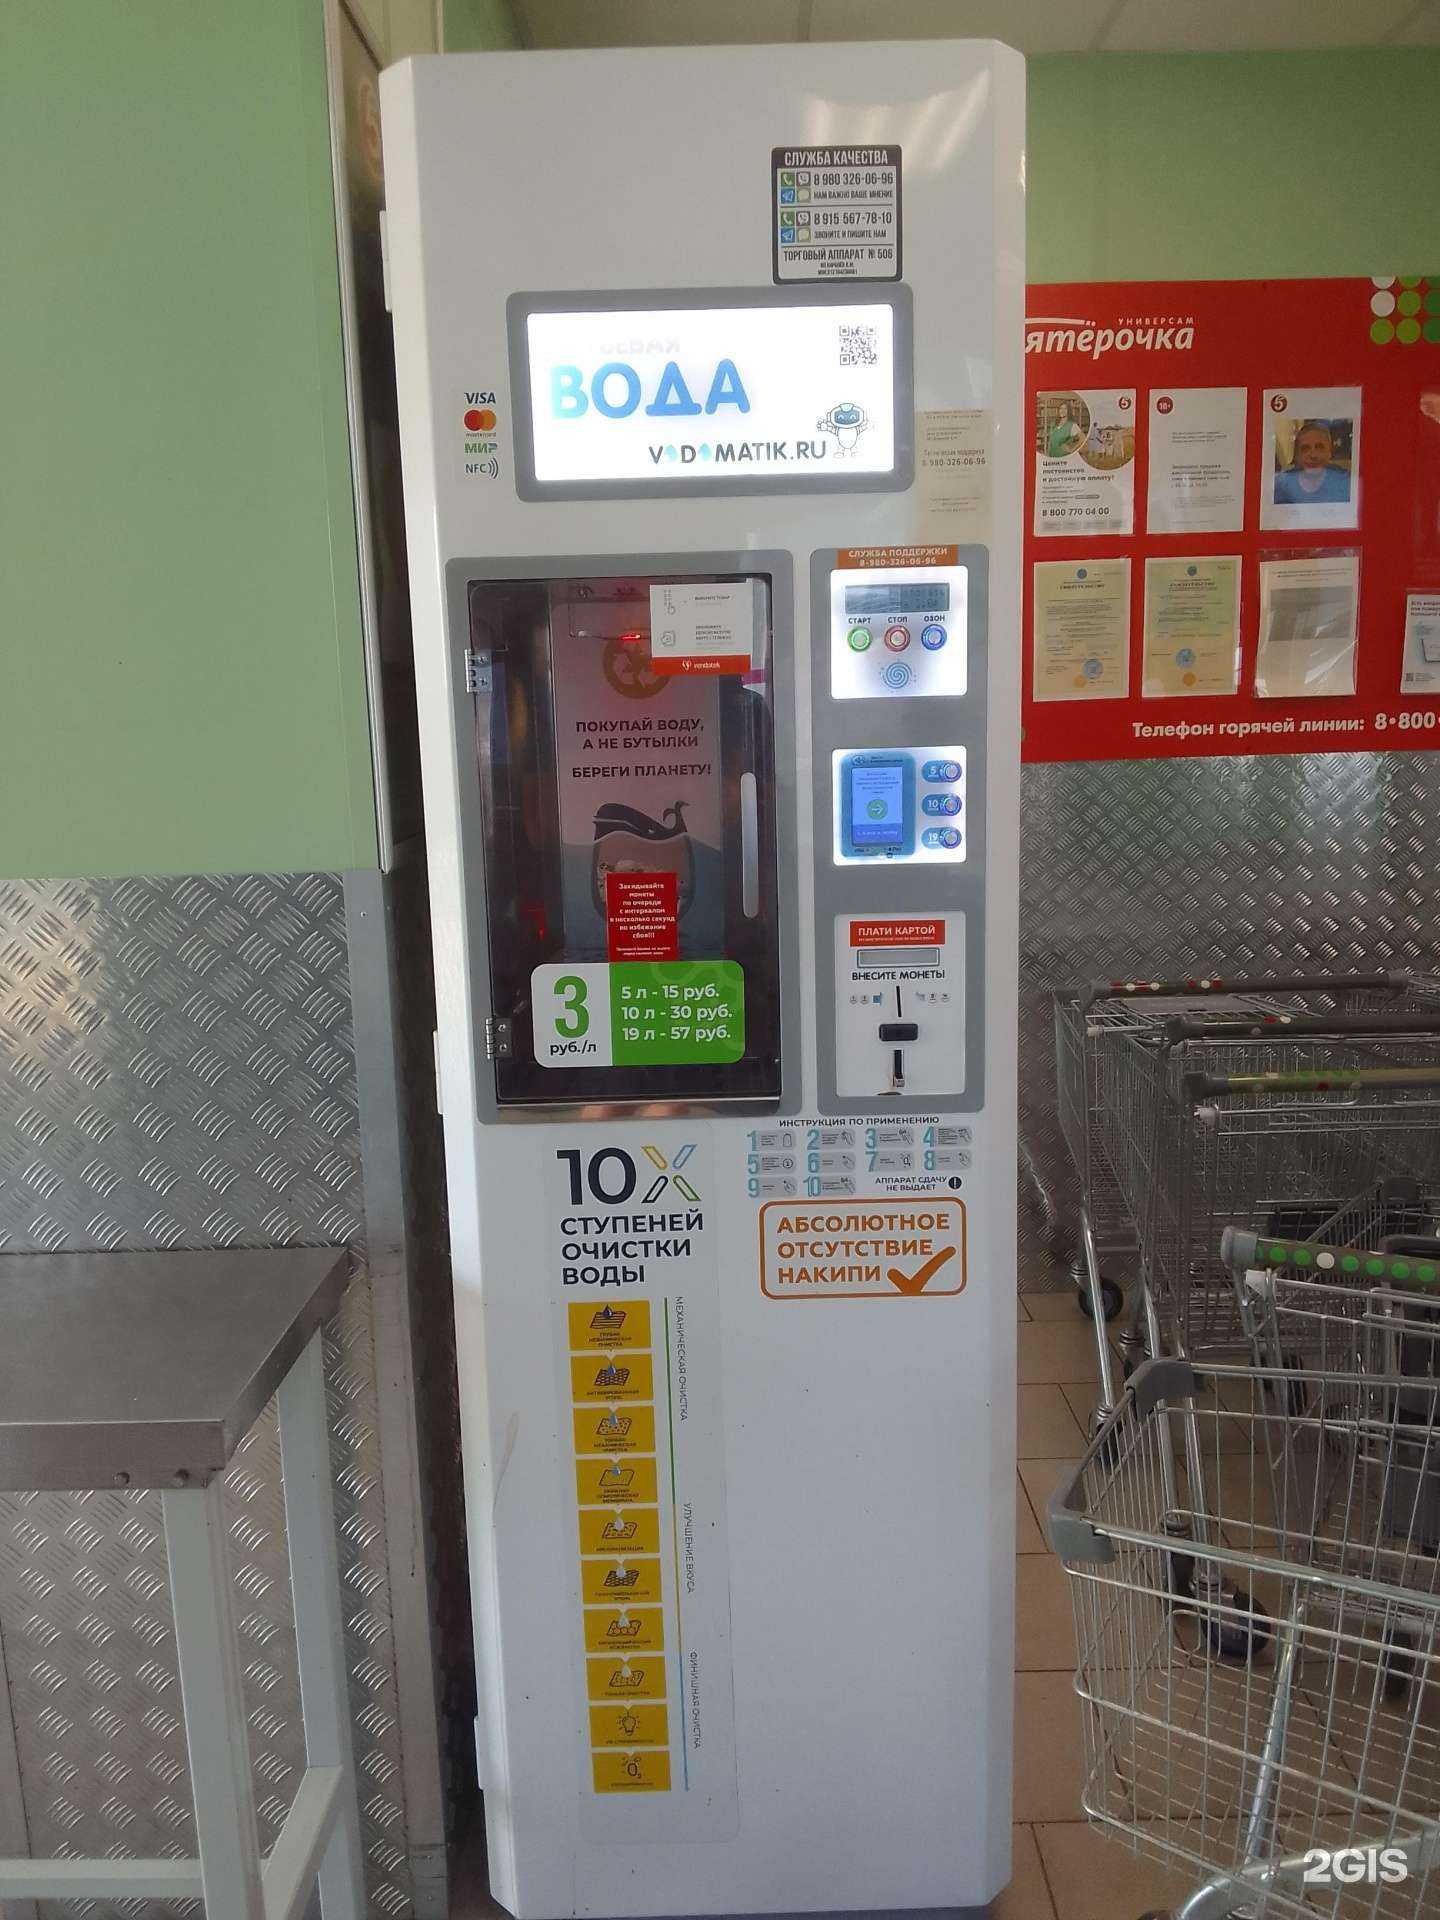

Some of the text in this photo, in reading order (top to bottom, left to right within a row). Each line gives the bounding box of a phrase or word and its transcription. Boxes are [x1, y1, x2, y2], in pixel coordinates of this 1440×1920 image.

[784, 150, 888, 166] СЛУЖБА КАЧЕСТВА
[814, 172, 893, 185] 8 980 326-06-96
[814, 189, 893, 199] НАМ ВАЖНО ВАШЕ МНЕНИЕ
[814, 213, 820, 225] 8
[822, 212, 839, 225] 915
[814, 230, 840, 239] ЗВОНИТЕ
[847, 230, 872, 238] ПИШИТЕ
[873, 229, 886, 238] НАМ
[784, 248, 826, 262] ТОРГОВЫЙ
[828, 248, 864, 260] АППАРАТ
[1118, 316, 1194, 326] УНИВЕРСАМ
[551, 358, 751, 419] ВОДА
[464, 392, 496, 404] VISA
[464, 442, 497, 454] МИР
[465, 463, 486, 473] NFC
[1068, 508, 1083, 516] 770
[1098, 507, 1110, 515] 00
[848, 547, 948, 558] СЛУЖБА ПОДДЕРЖКИ
[576, 717, 704, 733] ПОКУПАЙ ВОДУ,
[1132, 720, 1214, 739] Телефон
[1219, 717, 1295, 738] горячей
[1299, 719, 1364, 732] линии:
[583, 736, 698, 750] А НЕ БУТЫЛКИ
[572, 763, 712, 778] БЕРЕГИ ПЛАНЕТУ!
[927, 800, 939, 808] 10
[858, 924, 936, 936] ПЛАТИ КАРТОЙ
[852, 970, 945, 980] ВНЕСИТЕ МОНЕТЫ
[621, 986, 631, 999] 5
[635, 988, 647, 999] л
[662, 985, 679, 998] 15
[683, 983, 720, 1000] руб.
[553, 976, 590, 1039] 3
[621, 1006, 639, 1020] 10
[643, 1009, 655, 1019] л
[670, 1006, 692, 1019] 30
[696, 1003, 733, 1020] руб.
[622, 1027, 640, 1041] 19
[643, 1030, 655, 1041] л
[671, 1026, 691, 1039] 57
[695, 1024, 731, 1042] руб.
[550, 1041, 597, 1056] руб./л
[779, 1116, 940, 1128] ИНСТРУКЦИЯ ПО ПРИМЕНЕНИЮ
[747, 1131, 757, 1151] 1
[807, 1129, 820, 1150] 2
[865, 1128, 877, 1149] 3
[922, 1126, 935, 1148] 4
[748, 1154, 760, 1174] 5
[807, 1153, 820, 1173] 6
[865, 1151, 879, 1172] 7
[924, 1151, 936, 1171] 8
[748, 1178, 760, 1198] 9
[803, 1176, 821, 1197] 10
[875, 1176, 947, 1185] АППАРАТ СДАЧУ
[902, 1184, 936, 1192] ВЫДАЕТ
[560, 1208, 703, 1235] СТУПЕНЕЙ
[777, 1213, 950, 1233] АБСОЛЮТНОЕ
[562, 1239, 691, 1260] ОЧИСТКИ
[777, 1239, 933, 1259] ОТСУТСТВИЕ
[563, 1265, 645, 1287] ВОДЫ
[778, 1265, 881, 1283] НАКИПИ
[675, 1296, 688, 1421] МЕХАНИЧЕСКАЯ ОЧИСТКА
[684, 1502, 696, 1593] УЛУЧШЕНИЕ ВКУСА
[690, 1650, 701, 1748] ФИНИШНАЯ ОЧИСТКА
